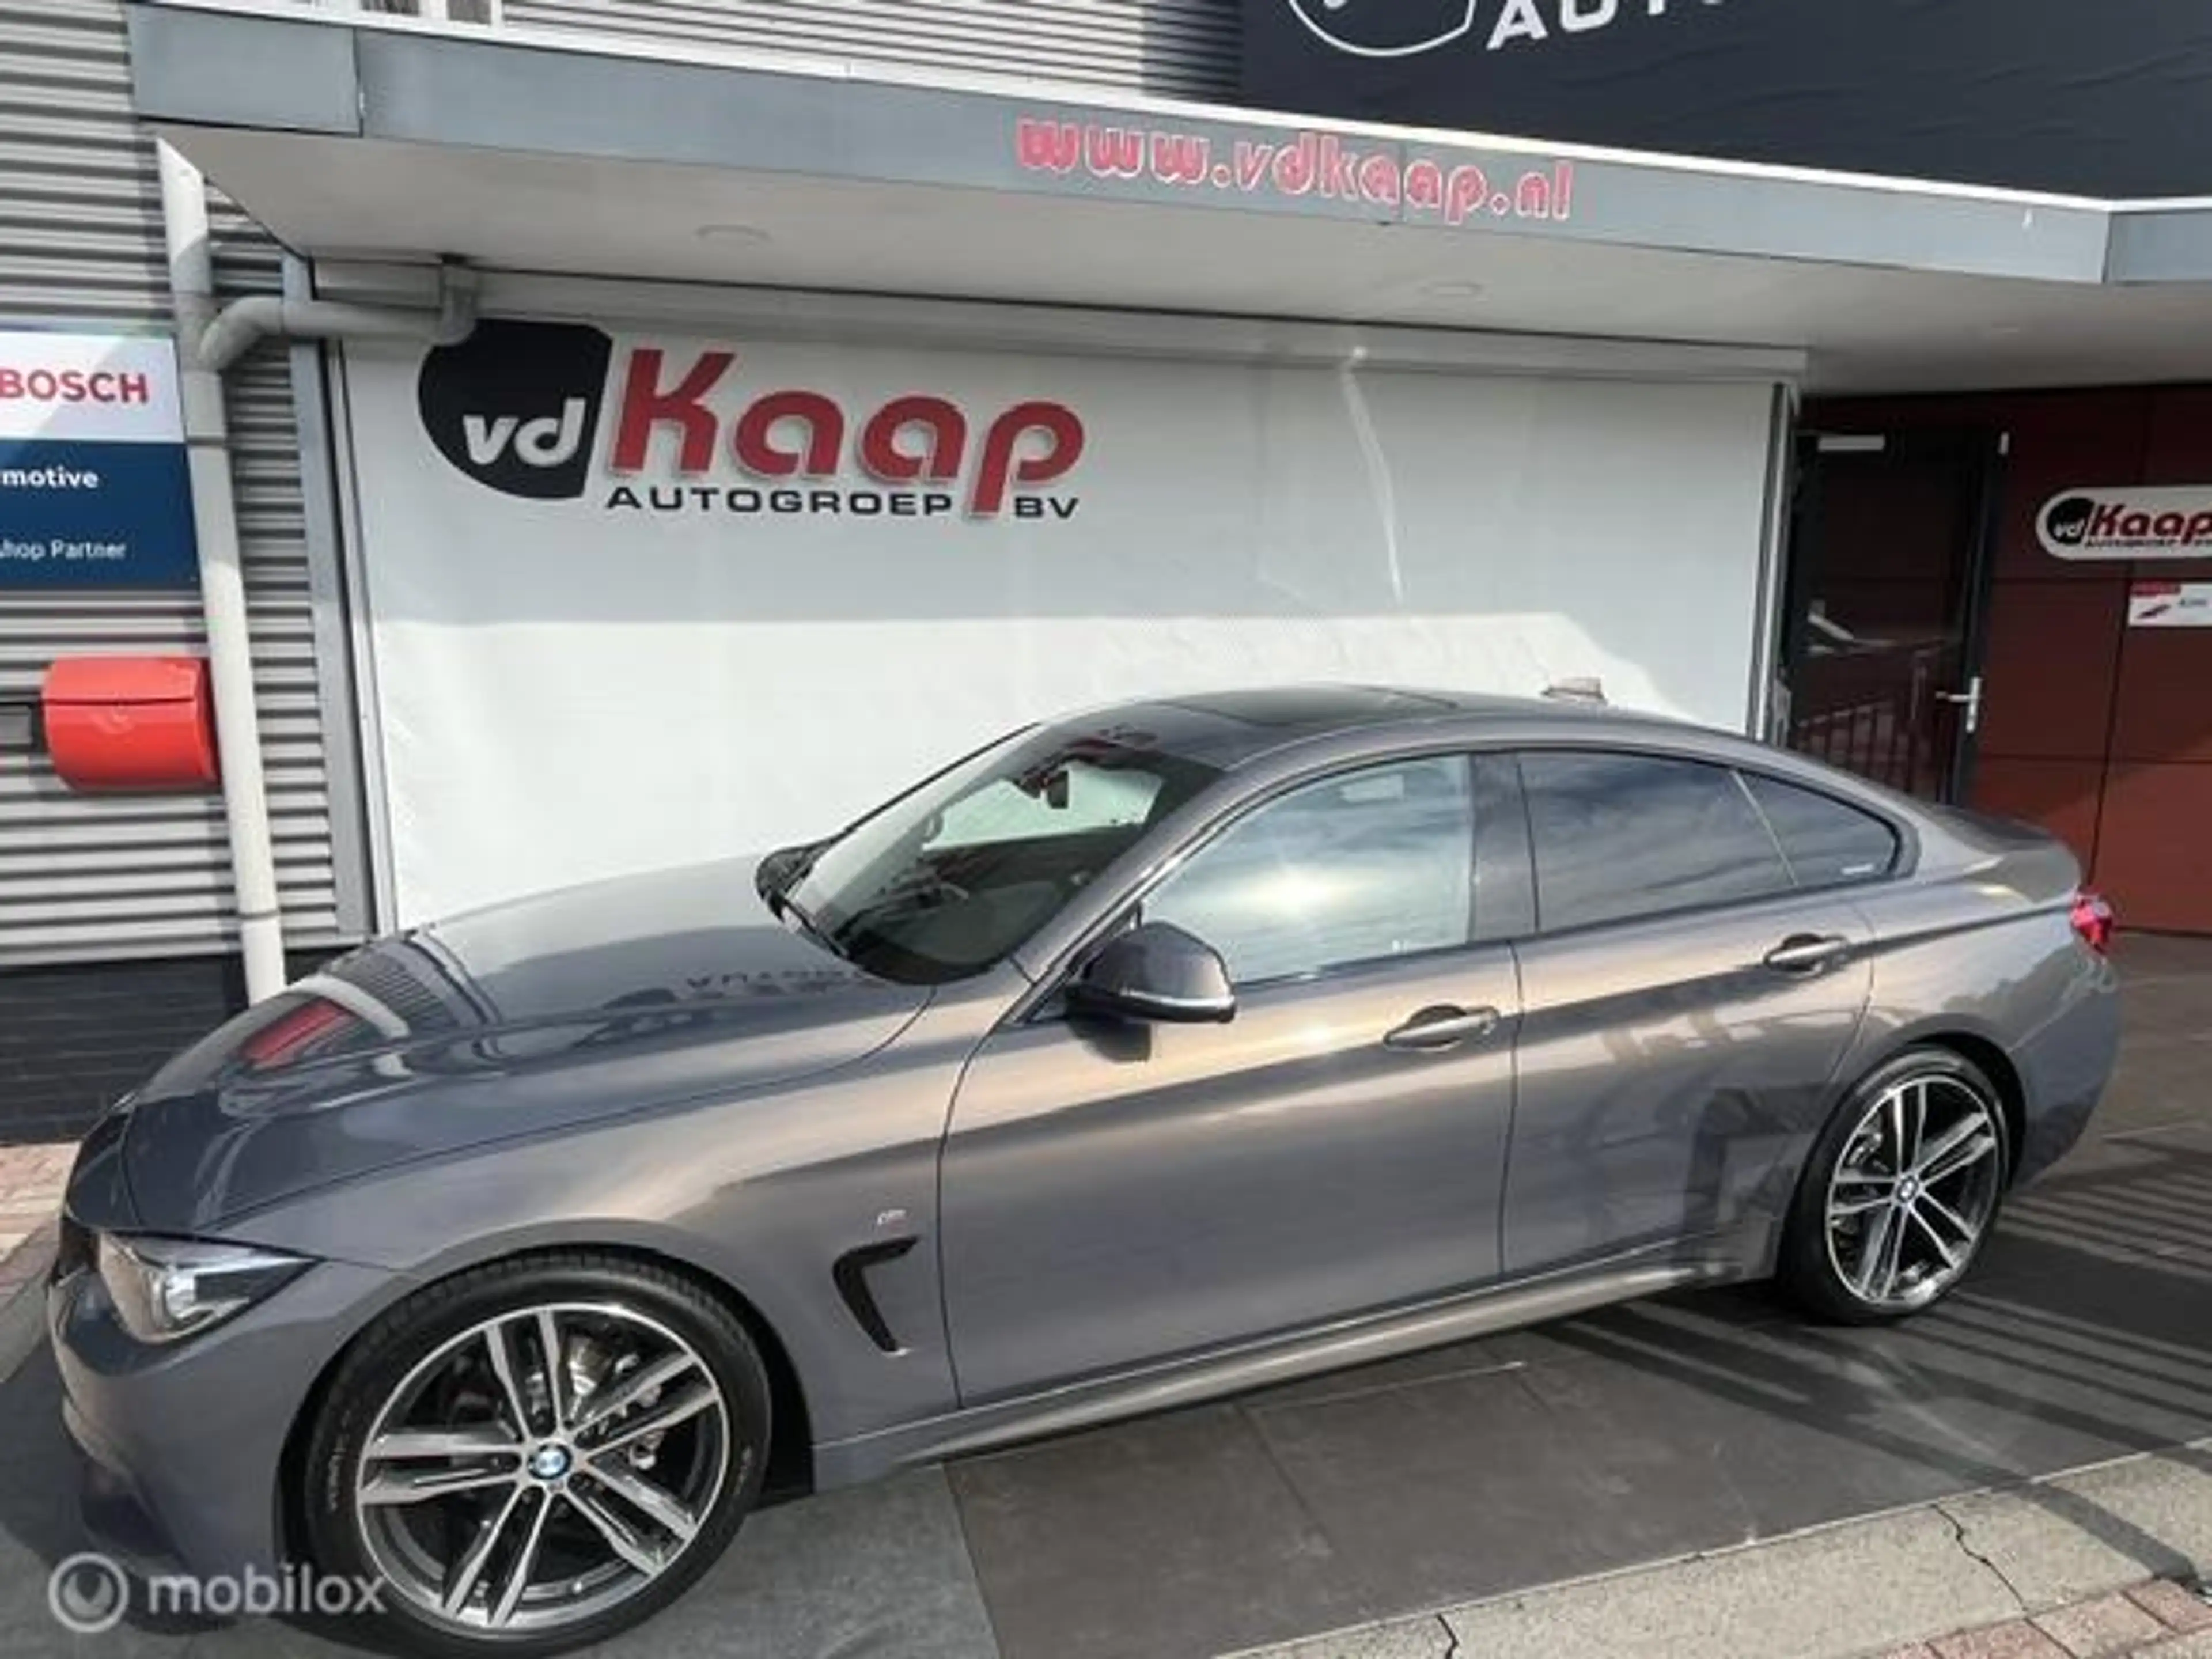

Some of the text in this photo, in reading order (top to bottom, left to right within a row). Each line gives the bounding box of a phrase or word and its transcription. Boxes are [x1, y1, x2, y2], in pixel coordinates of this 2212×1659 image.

[1016, 115, 1573, 225] www.vdkaap.nl
[0, 368, 149, 404] BOSCH
[461, 347, 1085, 521] vd Kaap
[605, 486, 1079, 520] AUTOGROEP BV
[2089, 503, 2212, 544] Kaap
[51, 539, 126, 559] Partner
